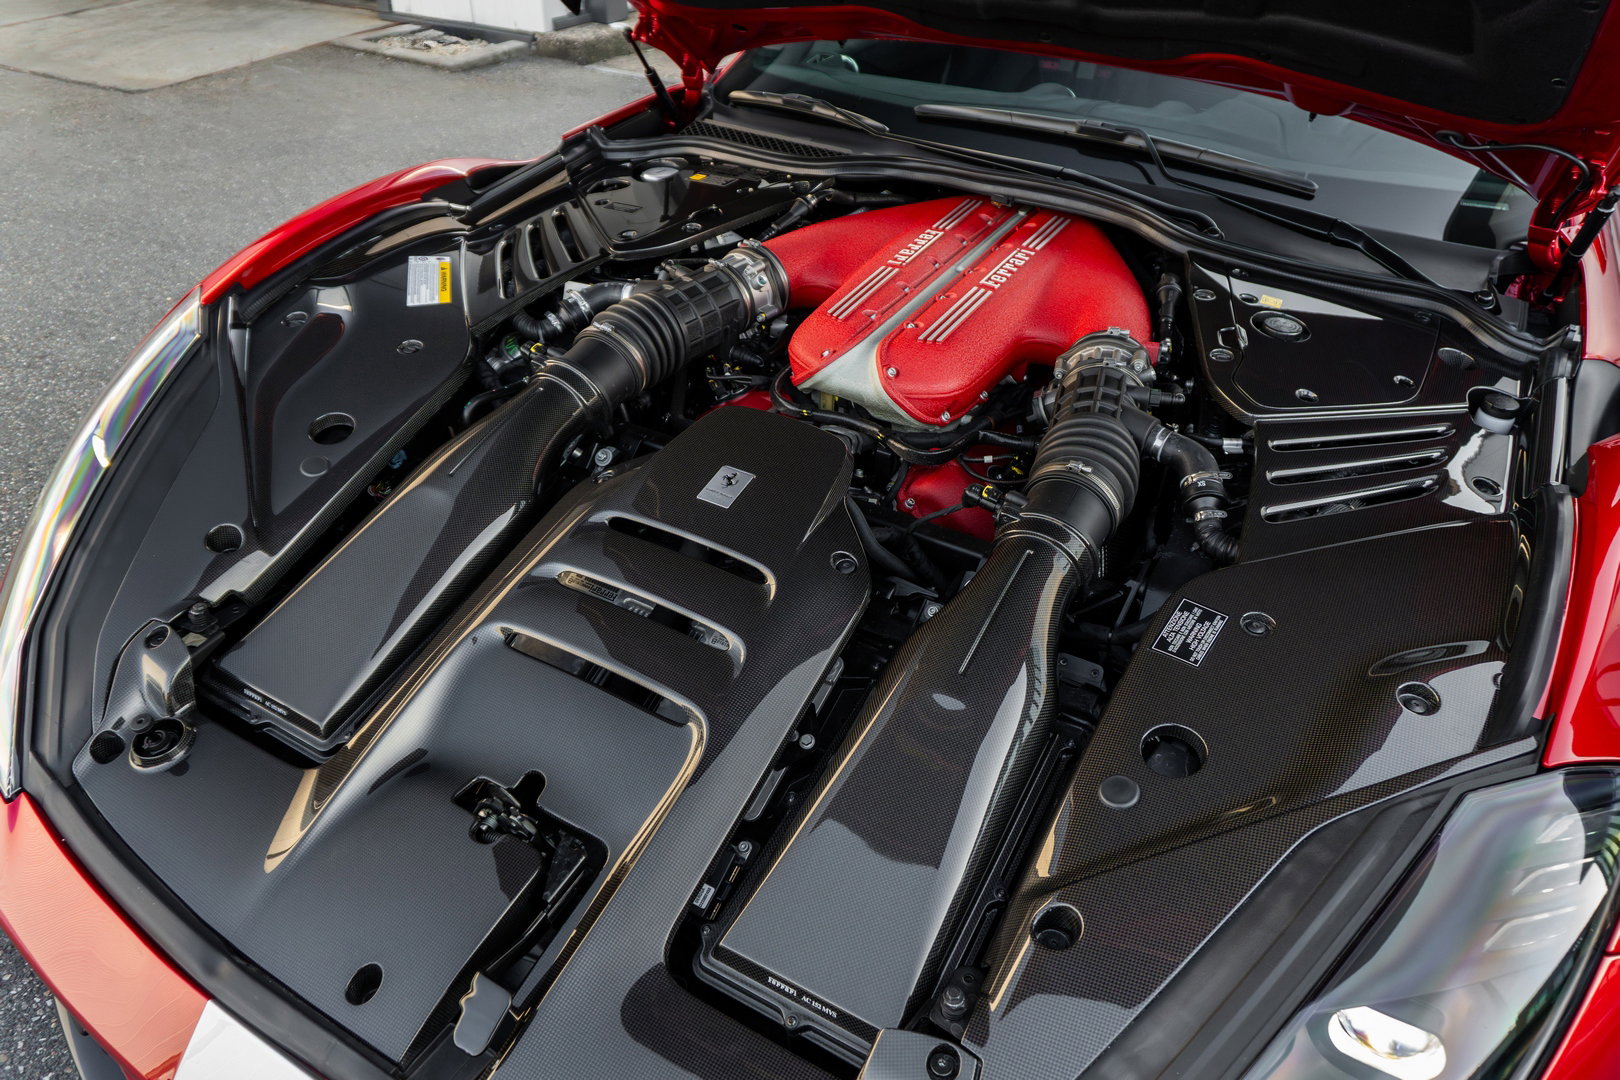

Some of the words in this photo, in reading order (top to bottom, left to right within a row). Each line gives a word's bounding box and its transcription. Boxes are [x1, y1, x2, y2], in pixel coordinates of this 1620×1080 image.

[888, 229, 944, 266] Ferrari
[979, 248, 1035, 289] Ferrari
[1186, 622, 1202, 643] WARNING
[1189, 638, 1200, 651] HIGH
[1196, 621, 1211, 640] VOLTAGE
[801, 995, 811, 1004] AC
[821, 1006, 838, 1018] MVS
